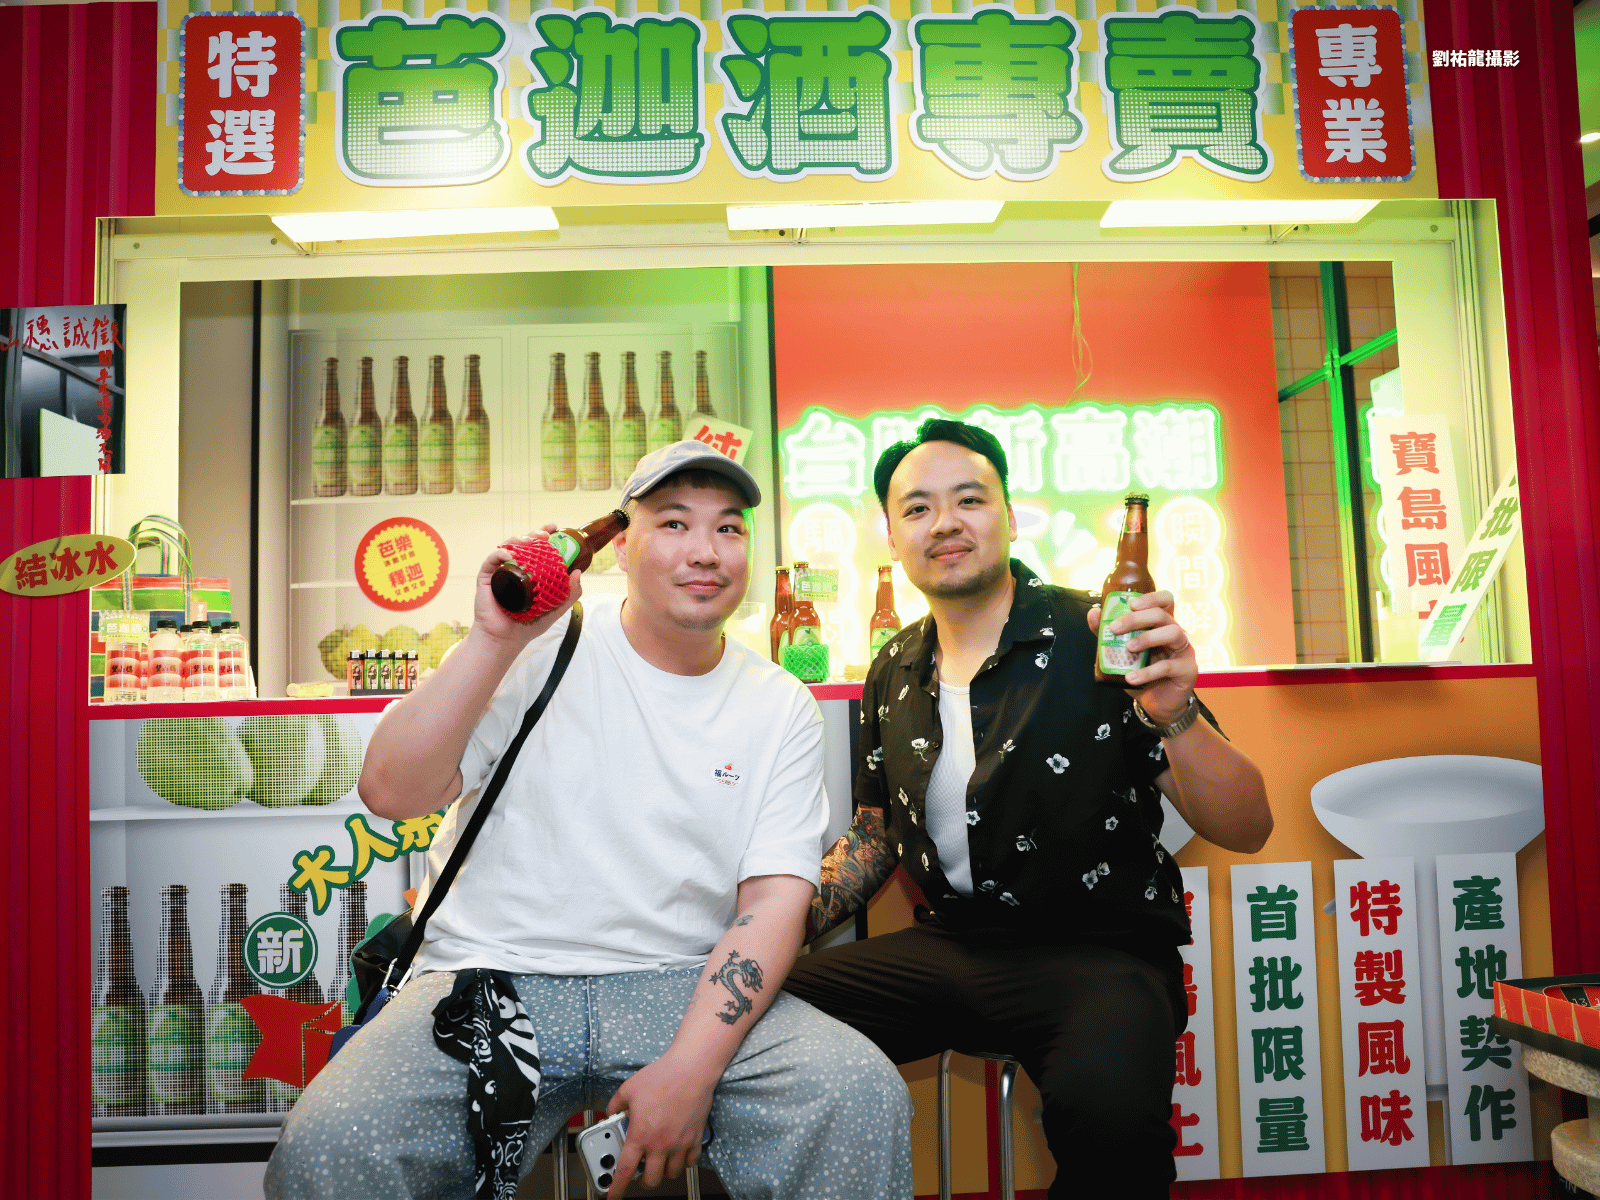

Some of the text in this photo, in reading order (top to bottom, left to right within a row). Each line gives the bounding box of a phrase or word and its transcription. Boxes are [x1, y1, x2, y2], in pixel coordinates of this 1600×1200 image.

[204, 30, 277, 177] 特選
[335, 12, 1268, 180] 芭迦酒專賣
[1315, 23, 1388, 164] 專業
[14, 541, 118, 590] 結冰水
[377, 533, 413, 558] 芭樂
[1421, 473, 1519, 646] 批限量
[256, 926, 305, 974] 新
[1246, 885, 1310, 1154] 首批限量
[1349, 879, 1416, 1147] 特製風味
[1452, 875, 1518, 1142] 產地契作
